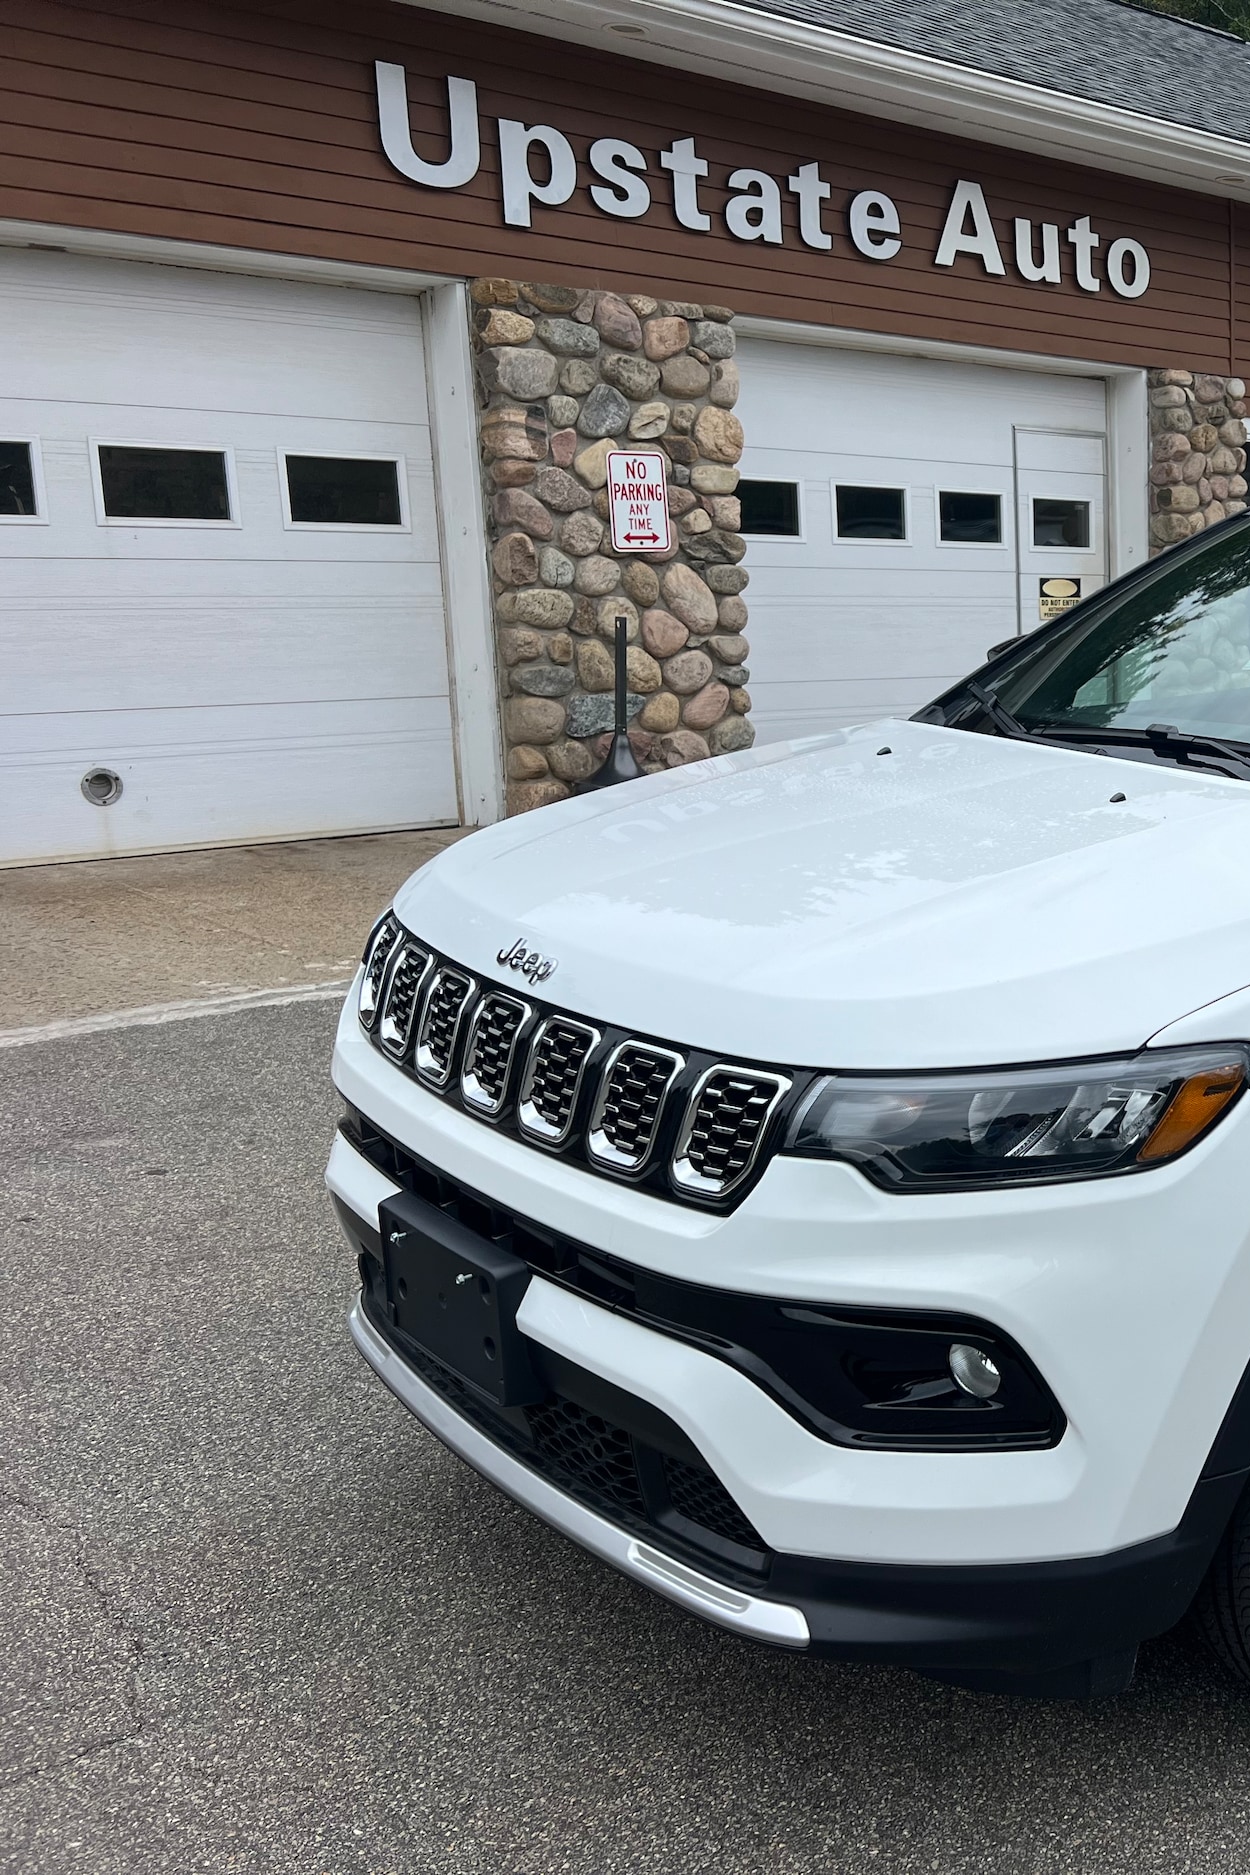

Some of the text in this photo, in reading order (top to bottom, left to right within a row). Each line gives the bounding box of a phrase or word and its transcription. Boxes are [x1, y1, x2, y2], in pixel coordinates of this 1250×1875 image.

[374, 59, 1152, 300] Upstate Auto
[625, 461, 647, 480] NO
[613, 483, 662, 502] PARKING
[629, 503, 650, 516] ANY
[628, 517, 653, 531] TIME
[496, 938, 558, 987] Jeep
